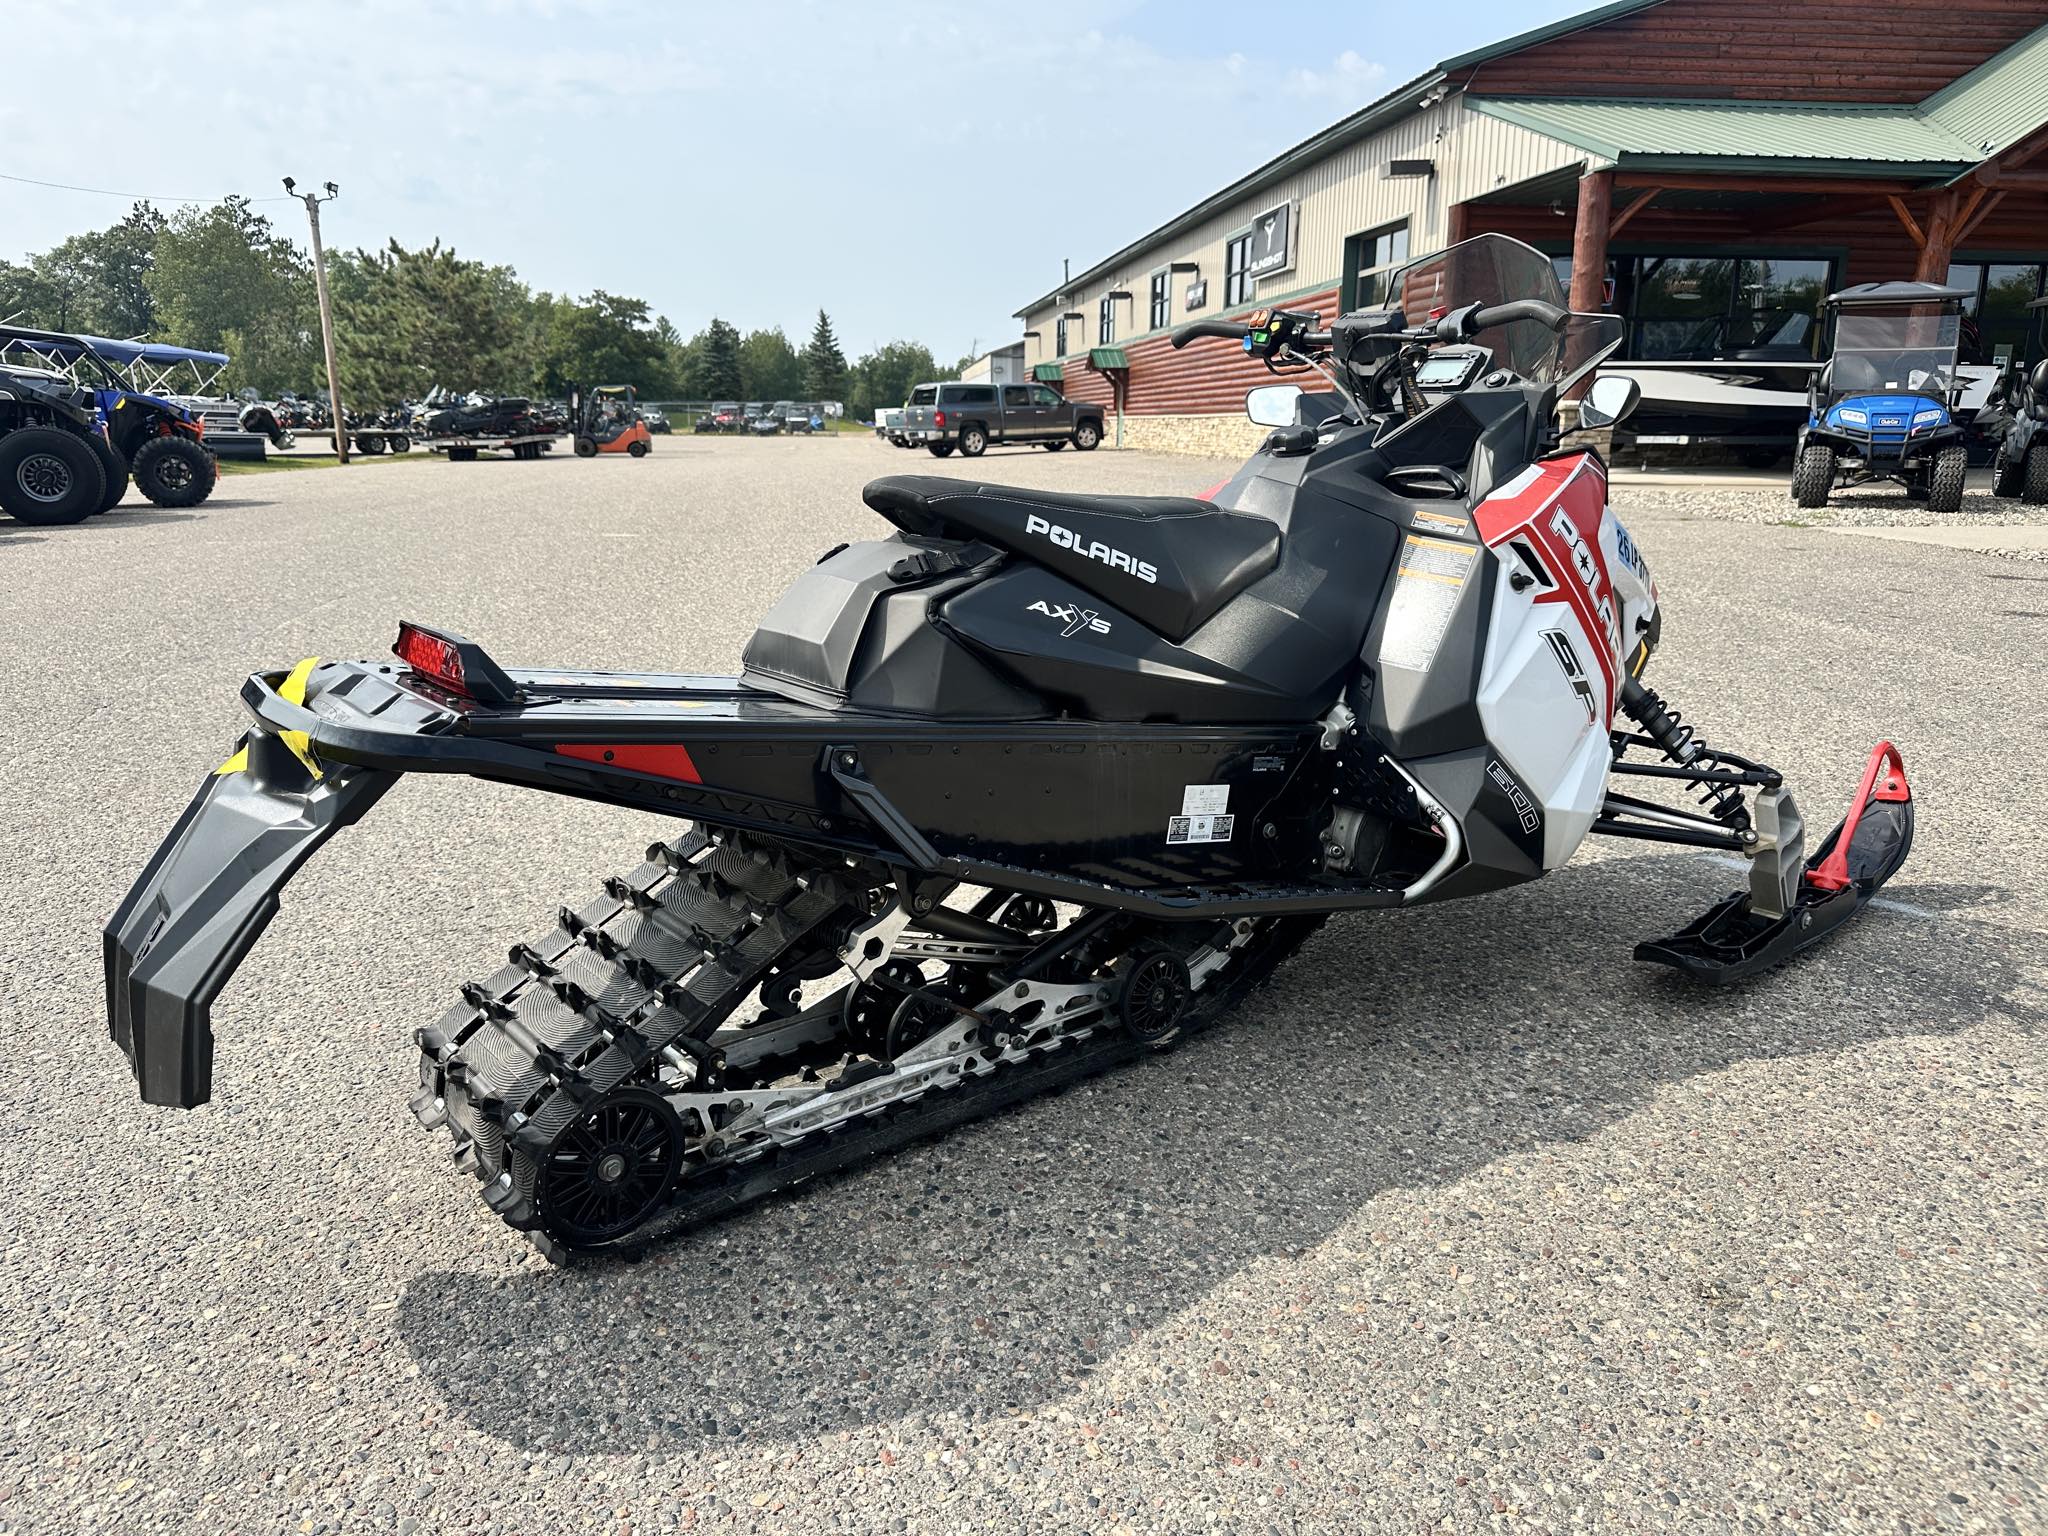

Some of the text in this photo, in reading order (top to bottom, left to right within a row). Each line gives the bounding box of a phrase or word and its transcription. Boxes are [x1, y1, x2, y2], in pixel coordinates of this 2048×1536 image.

[1026, 514, 1158, 584] POLARIS
[1616, 528, 1630, 563] 26
[1549, 504, 1625, 696] POLAR
[1538, 628, 1597, 726] SP
[1486, 760, 1540, 835] 500
